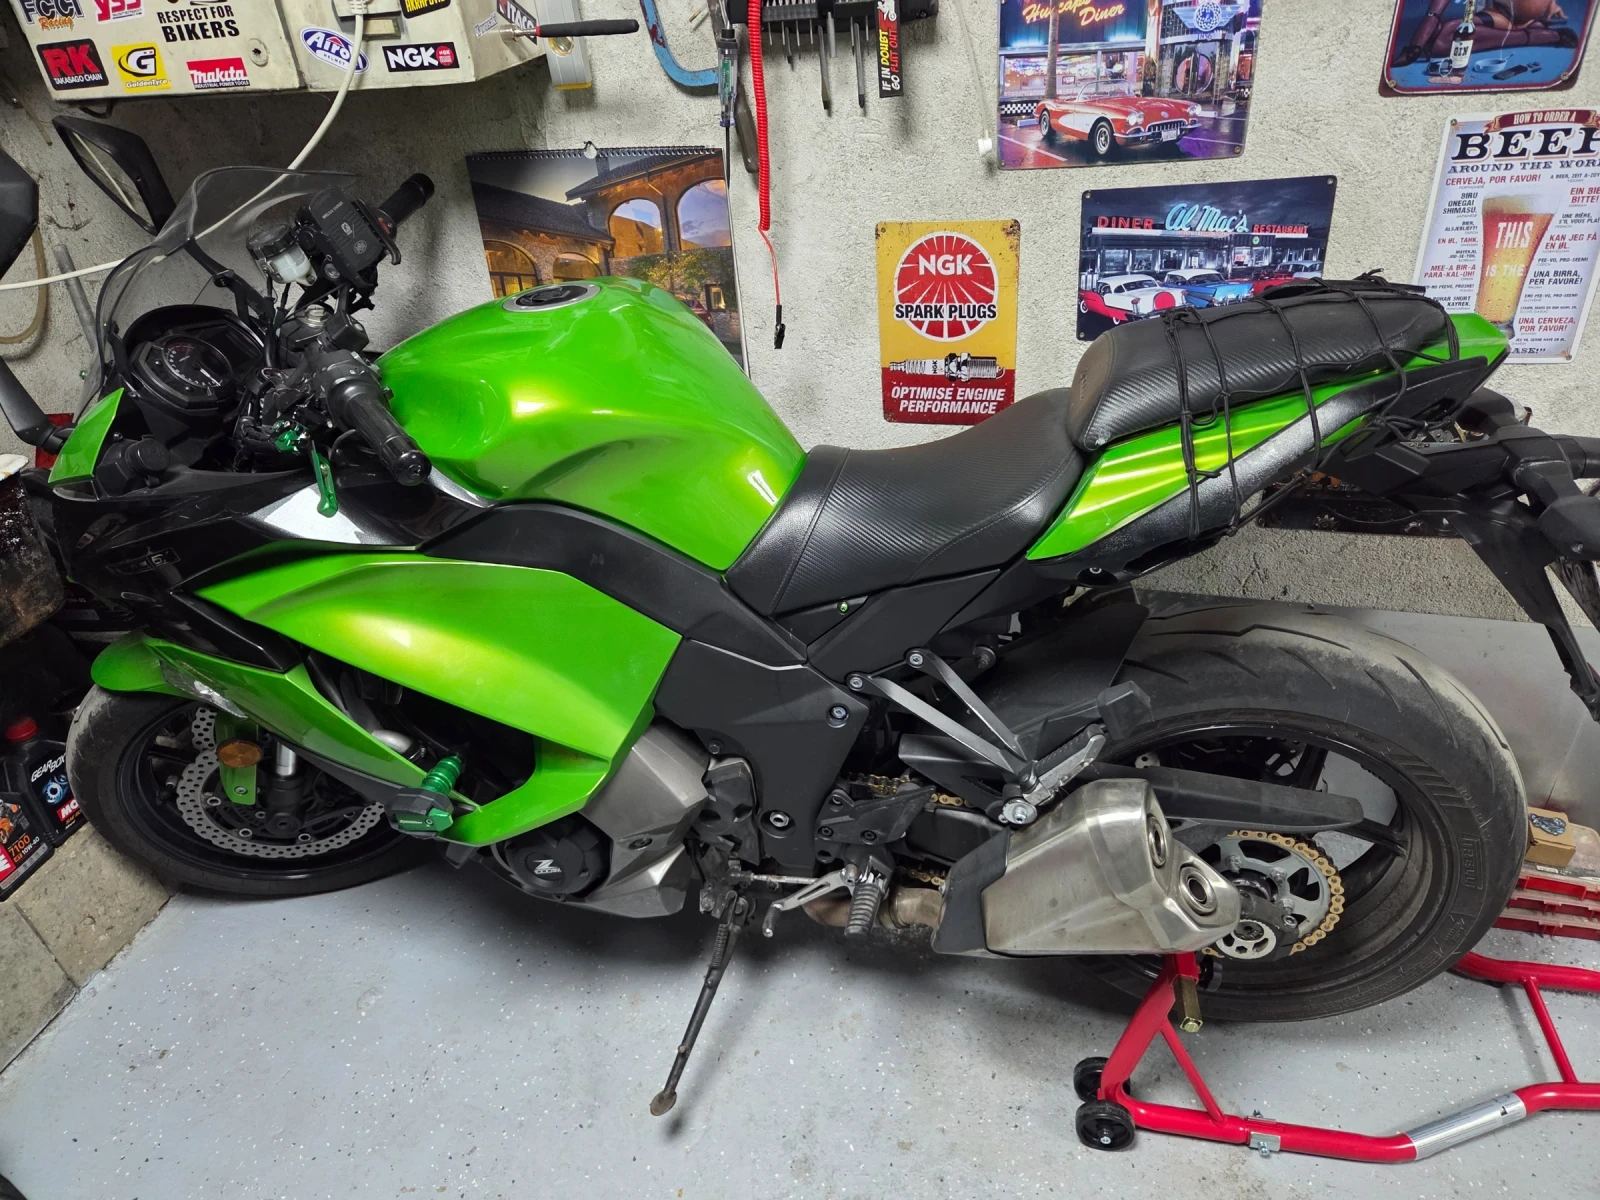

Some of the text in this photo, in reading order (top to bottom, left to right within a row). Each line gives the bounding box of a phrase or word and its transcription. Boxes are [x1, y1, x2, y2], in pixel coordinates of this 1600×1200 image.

[157, 5, 234, 24] RESPECT FOR
[1079, 4, 1124, 26] Diner
[38, 16, 74, 31] Racing
[162, 20, 240, 42] BIKERS
[386, 46, 438, 69] NGK
[1453, 46, 1469, 56] GIN
[42, 45, 100, 78] RK
[324, 54, 345, 66] HELMET
[879, 29, 891, 90] IF IN DOUBT
[888, 28, 900, 90] GO FLAT OUT
[53, 74, 103, 84] TAKASAGO CHAIN
[190, 66, 248, 84] makita
[126, 79, 168, 88] GoldenTyre
[1513, 111, 1576, 124] HOW TO ORDER A
[1447, 160, 1600, 174] AROUND THE WOR
[1446, 177, 1486, 186] CERVEJA,
[1510, 174, 1541, 183] FAVOR!
[1571, 195, 1599, 203] BITTE!
[1098, 203, 1308, 234] DINER Al Mac's RESTAURANT
[1496, 222, 1534, 248] THIS
[918, 254, 973, 276] NGK
[1485, 264, 1525, 277] IS THE
[895, 304, 996, 319] SPARK PLUGS
[892, 386, 1006, 401] OPTIMISE ENGINE
[900, 401, 997, 414] PERFORMANCE
[9, 835, 30, 856] 7100
